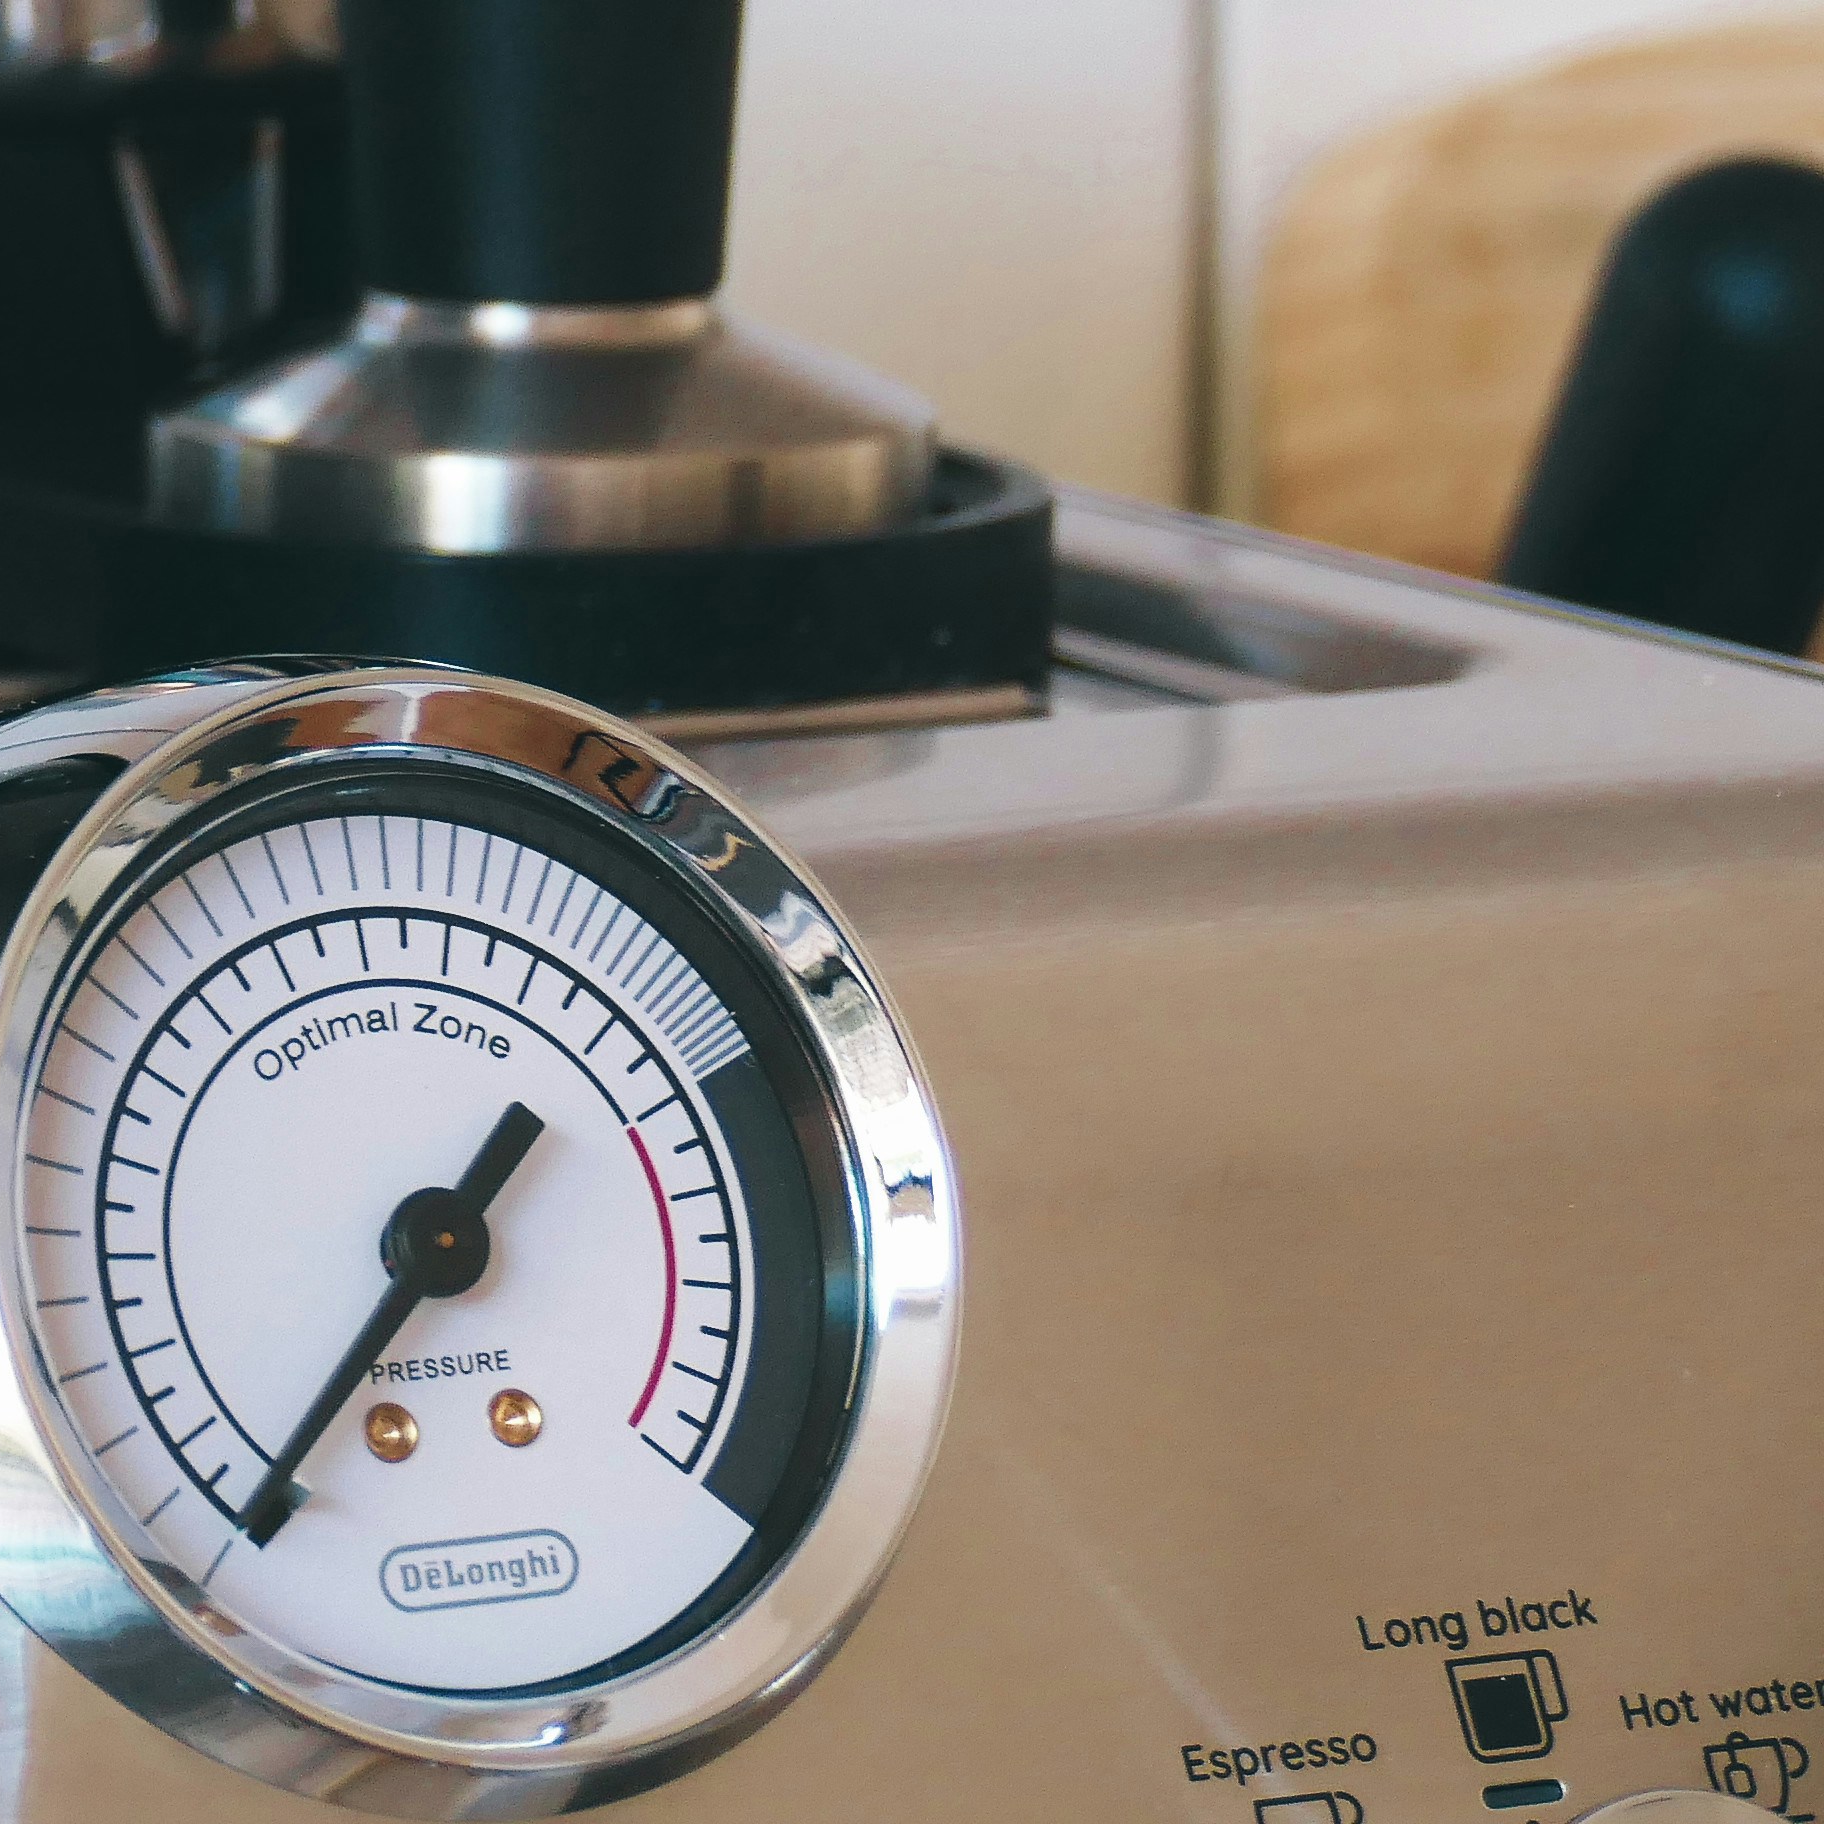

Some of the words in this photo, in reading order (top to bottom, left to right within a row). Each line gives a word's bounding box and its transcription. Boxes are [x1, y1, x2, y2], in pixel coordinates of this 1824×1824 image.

[253, 1001, 399, 1081] Optimal
[412, 1002, 511, 1059] Zone
[370, 1348, 512, 1386] PRESSURE
[1355, 1611, 1470, 1652] Long
[1475, 1588, 1599, 1638] black
[1618, 1689, 1700, 1731] Hot
[1180, 1733, 1378, 1787] Espresso
